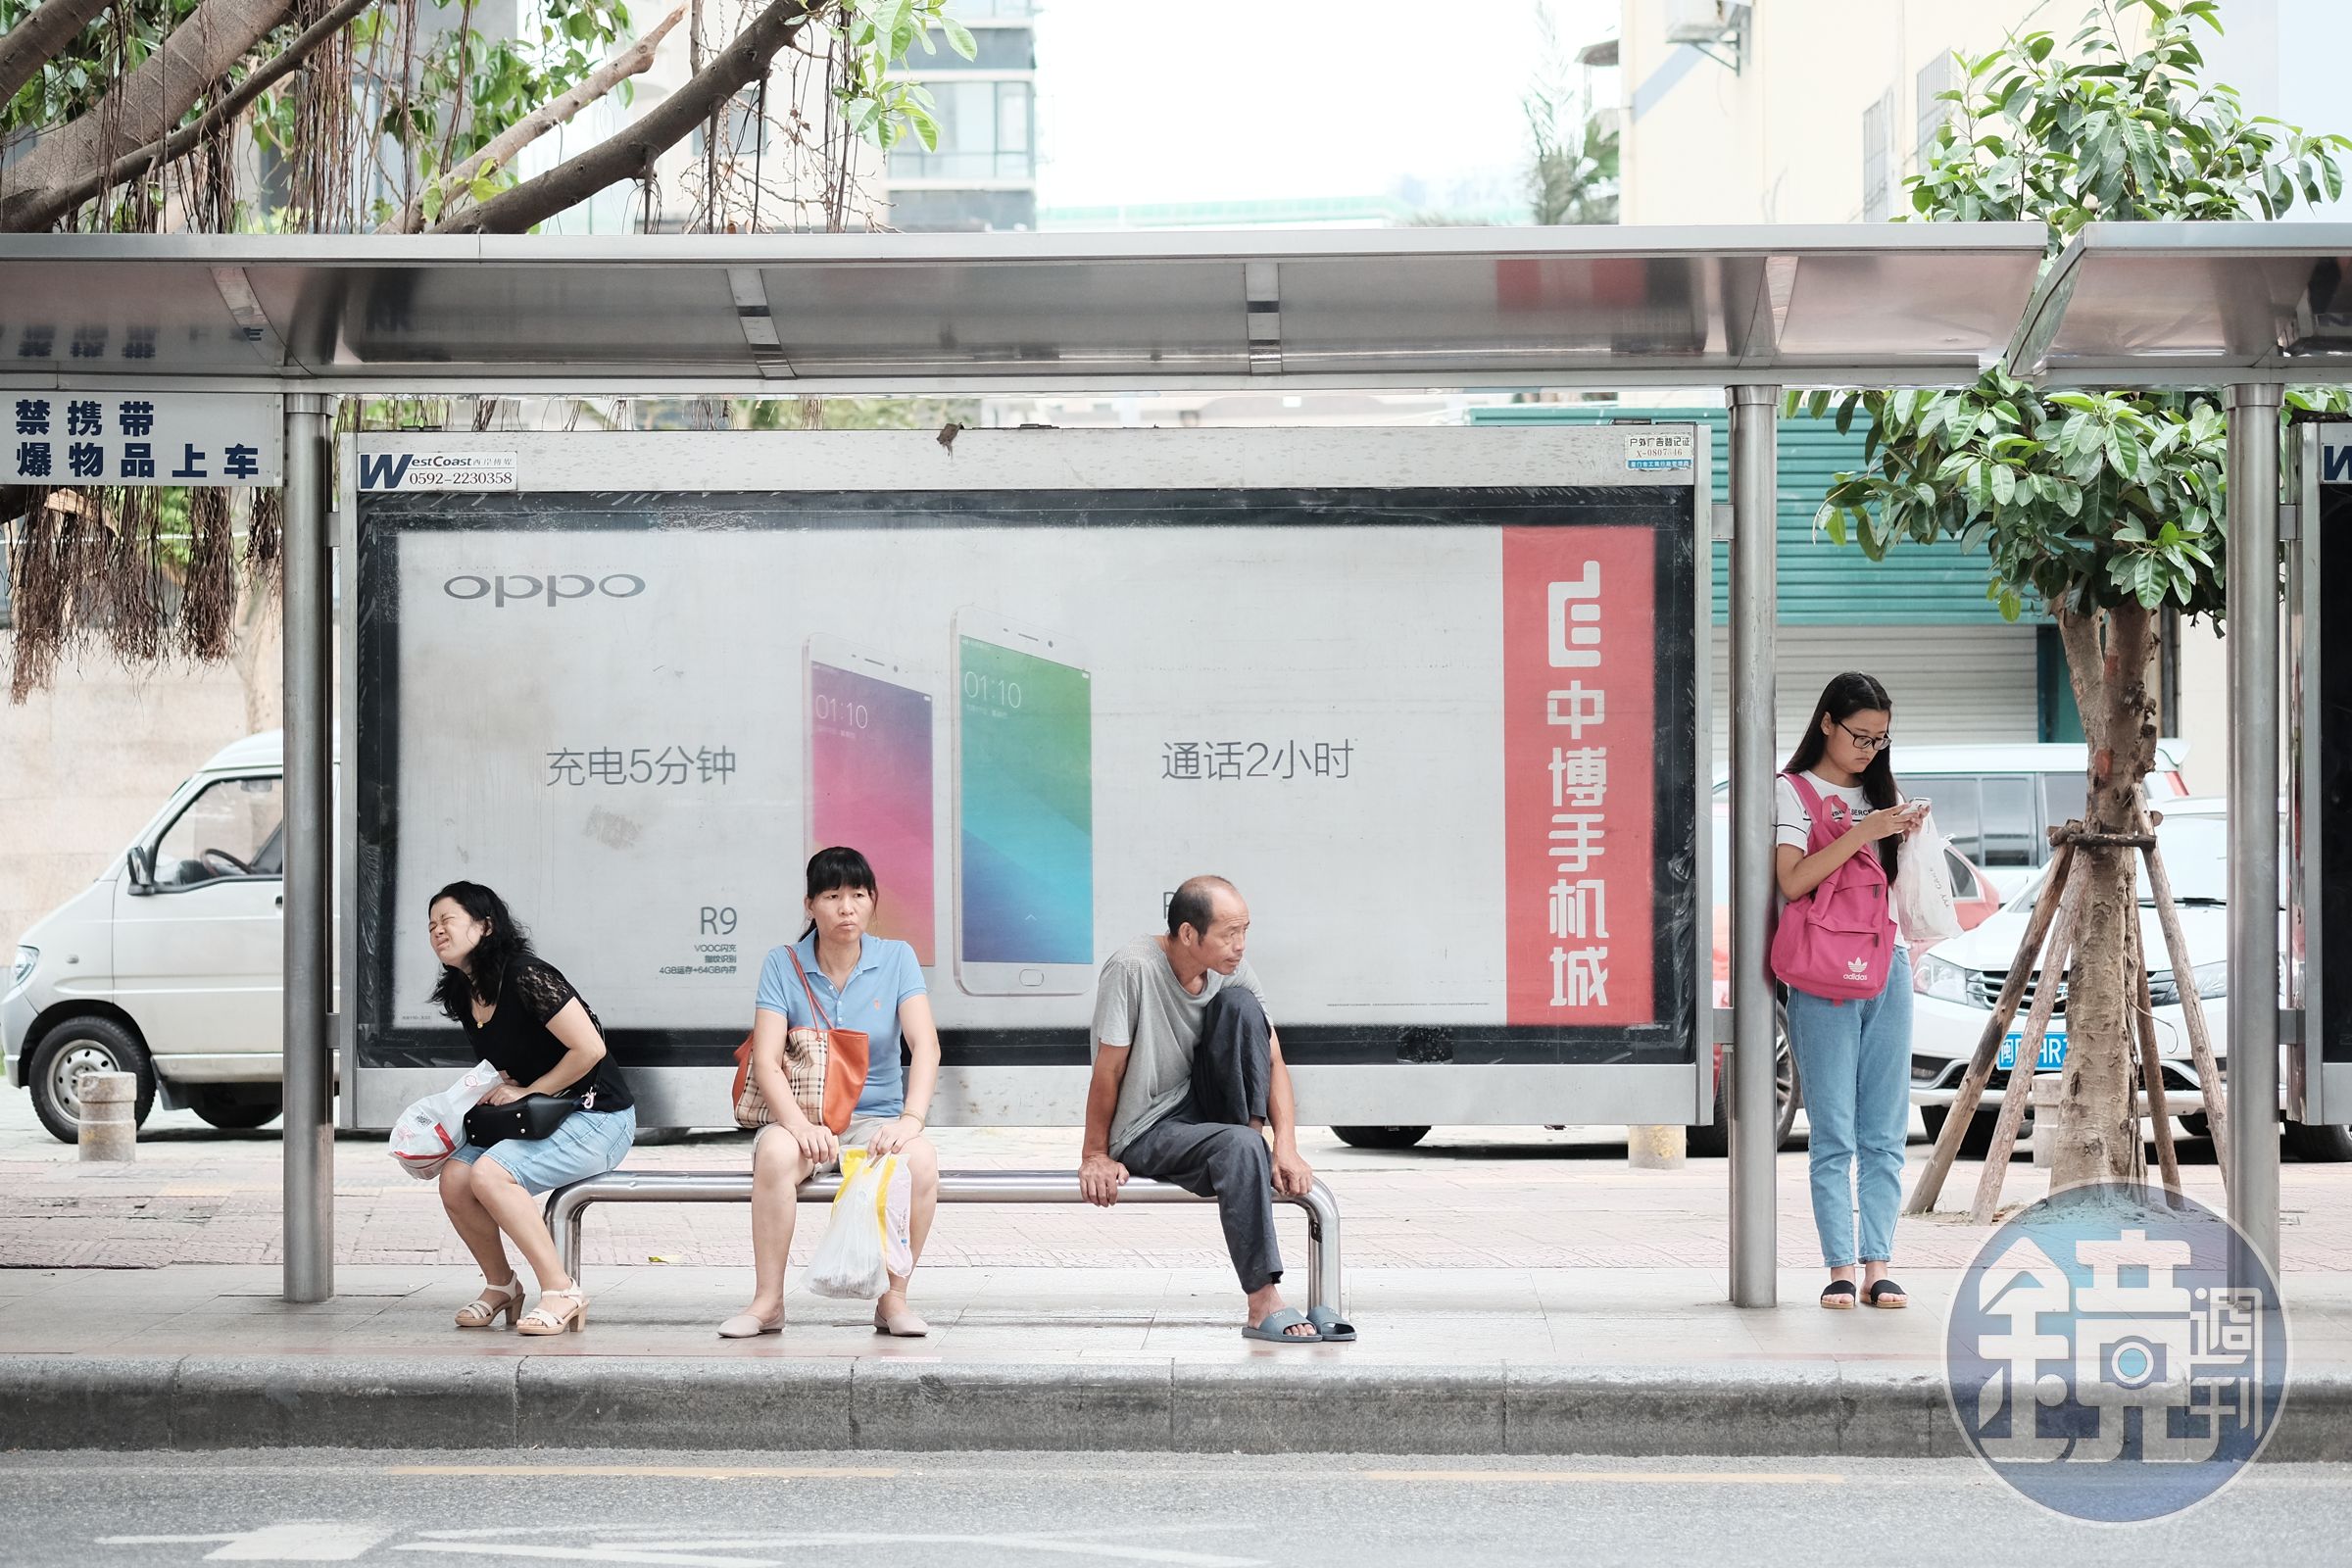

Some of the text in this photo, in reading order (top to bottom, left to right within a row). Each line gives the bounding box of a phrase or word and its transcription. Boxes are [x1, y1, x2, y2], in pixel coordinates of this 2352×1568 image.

[15, 399, 155, 436] 禁携带
[15, 441, 260, 479] 爆物品上车
[1629, 437, 1690, 447] 户外广告登记证
[409, 472, 513, 485] 0592-2230358
[964, 670, 1021, 709] 01:10
[814, 694, 868, 729] 01:10
[545, 745, 736, 786] 充电5分钟
[1161, 738, 1354, 780] 通话2小时
[1546, 679, 1609, 1006] 中博手机城
[701, 906, 737, 935] R9
